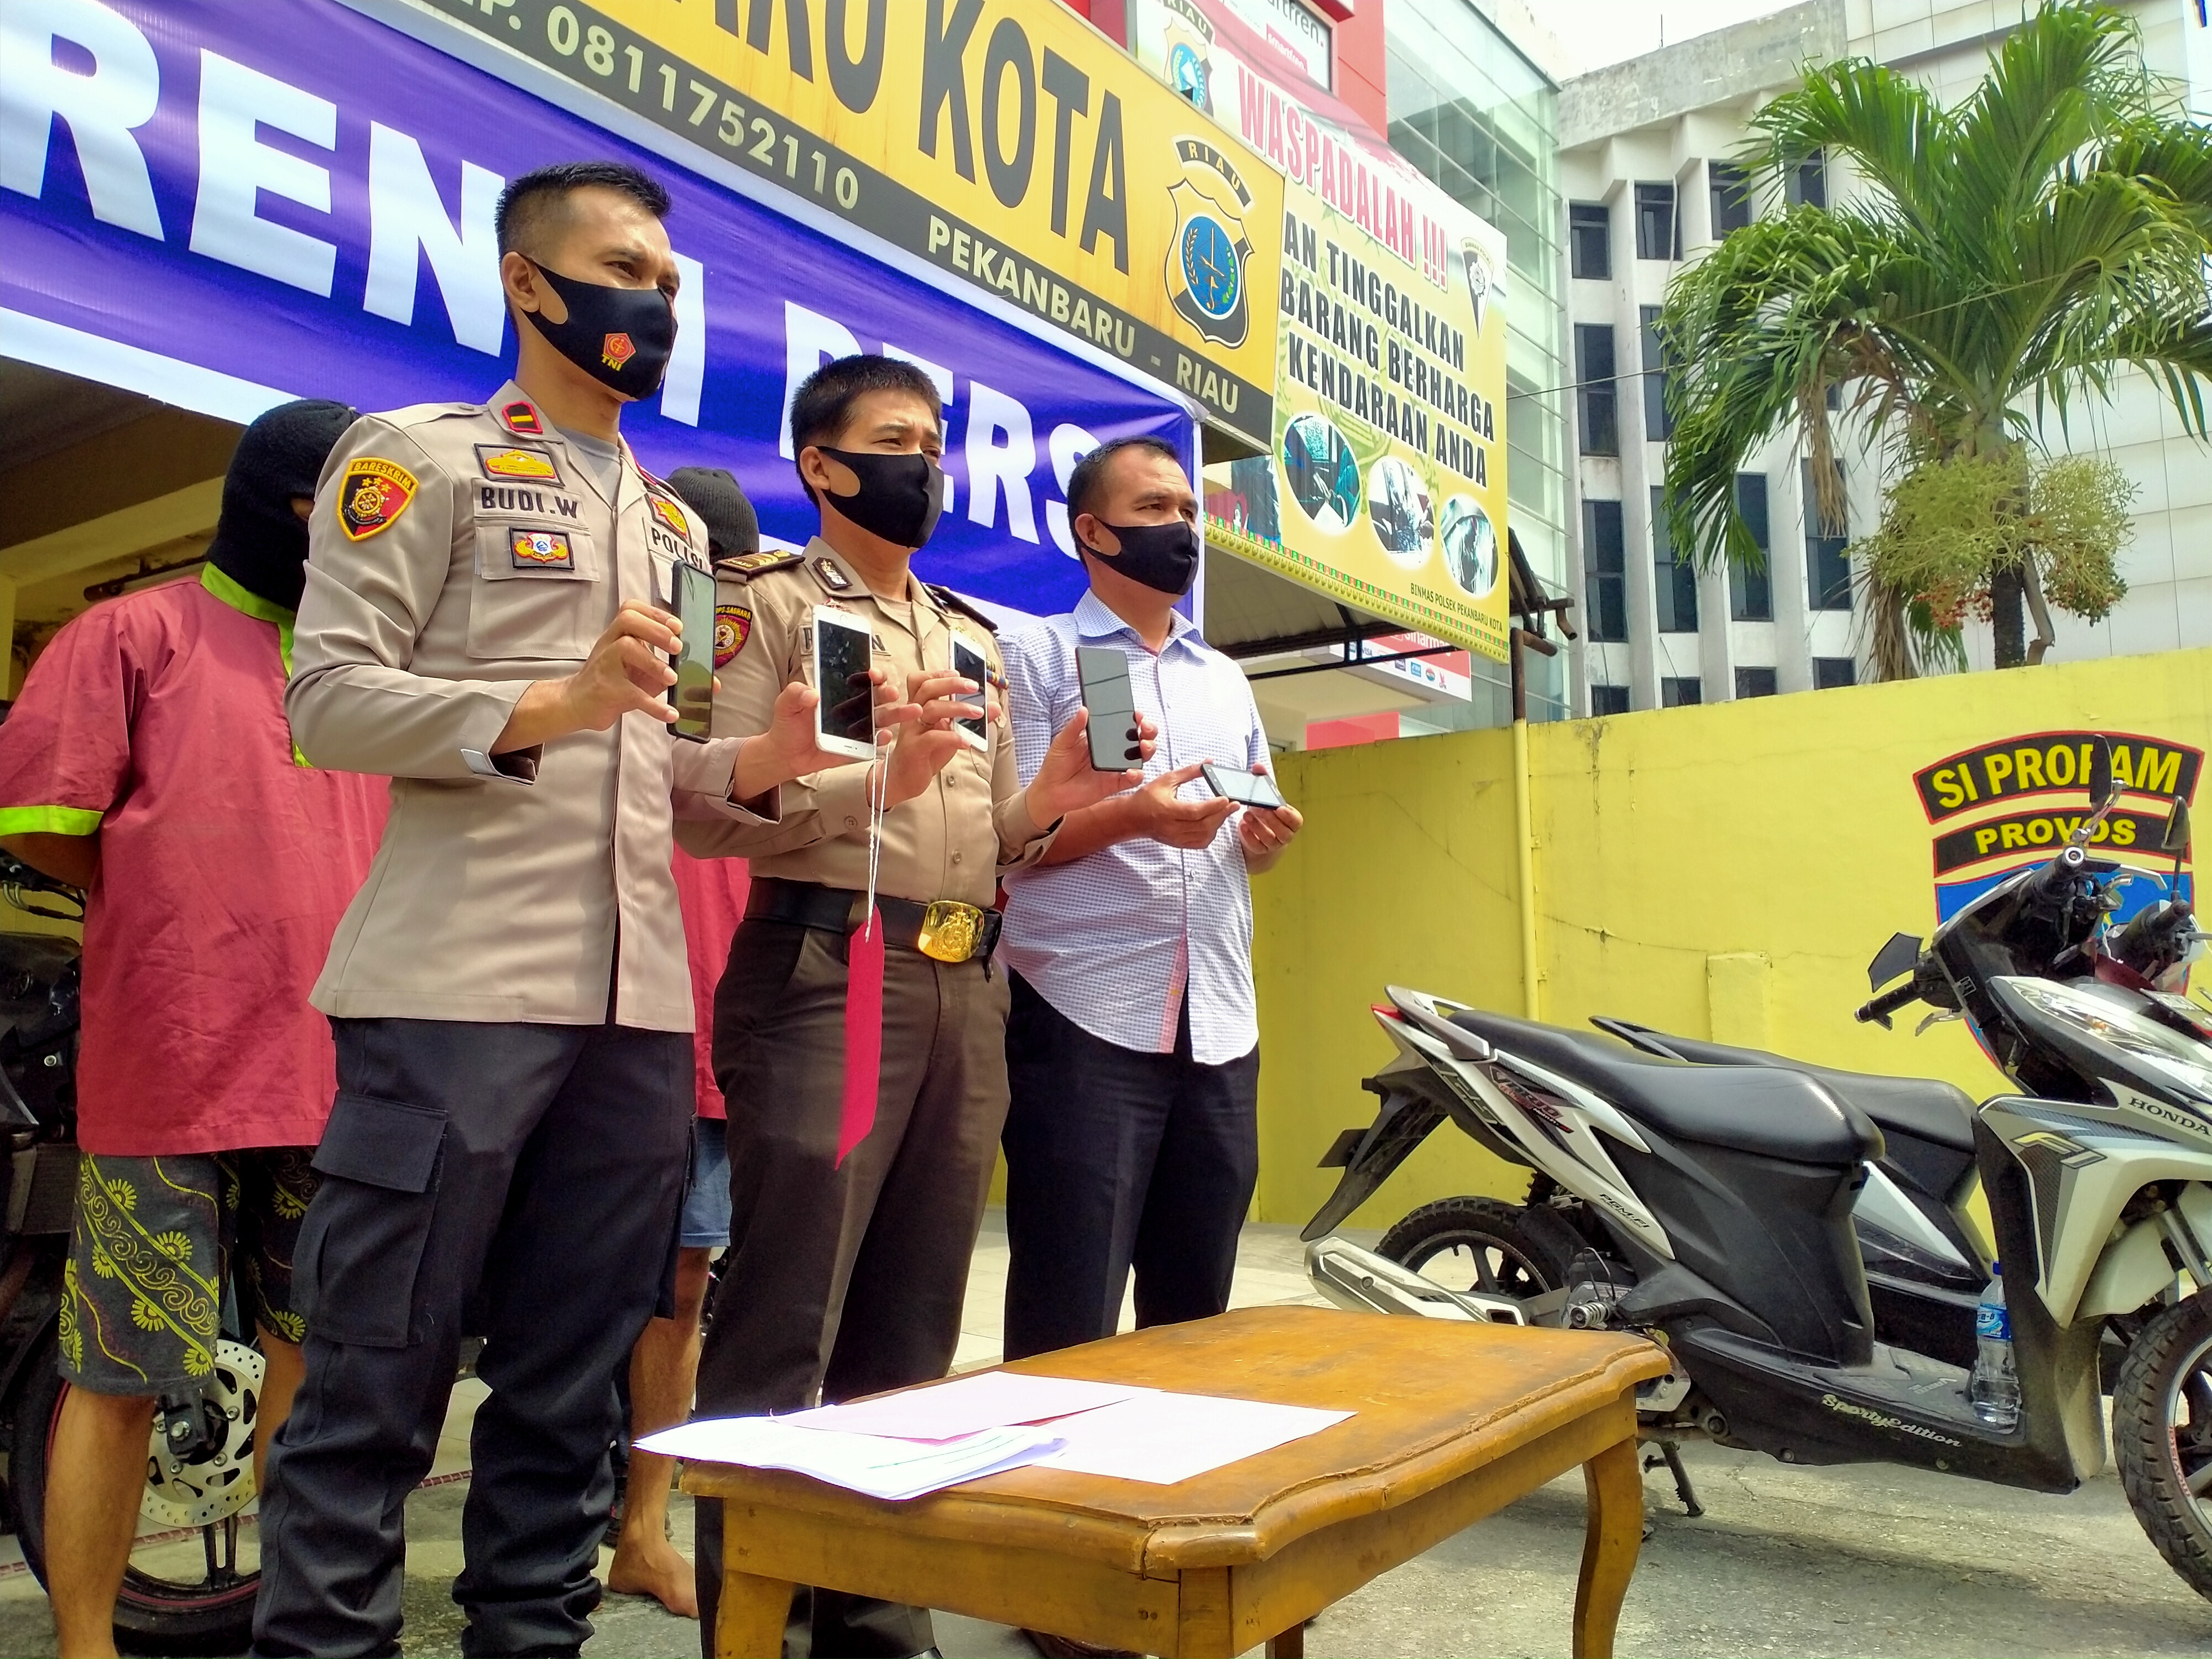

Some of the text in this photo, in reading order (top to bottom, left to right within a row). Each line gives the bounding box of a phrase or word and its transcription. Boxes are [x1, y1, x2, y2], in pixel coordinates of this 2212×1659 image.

[547, 4, 859, 211] 0811752110
[918, 0, 1129, 276] KOTA
[1188, 140, 1240, 189] RIAU
[1238, 62, 1448, 289] WASPADALAH !!!
[0, 0, 704, 427] RENI
[928, 215, 1135, 359] PEKANBARU
[1176, 355, 1239, 415] RIAU
[1284, 210, 1464, 373] AN TINGGALKAN
[601, 353, 623, 372] TNI
[1281, 267, 1495, 443] BARANG BERHARGA
[1288, 333, 1488, 488] KENDARAAN ANDA
[354, 462, 411, 489] BARESKRIM
[481, 487, 578, 519] BUDI.W
[1410, 582, 1503, 633] BINMAS POLSEK PEKANBARU KOTA
[1932, 763, 1979, 809] SI
[1975, 816, 2137, 854] PROVOS
[2128, 1096, 2211, 1136] HONDA
[1599, 1194, 1650, 1228] PGM-FI
